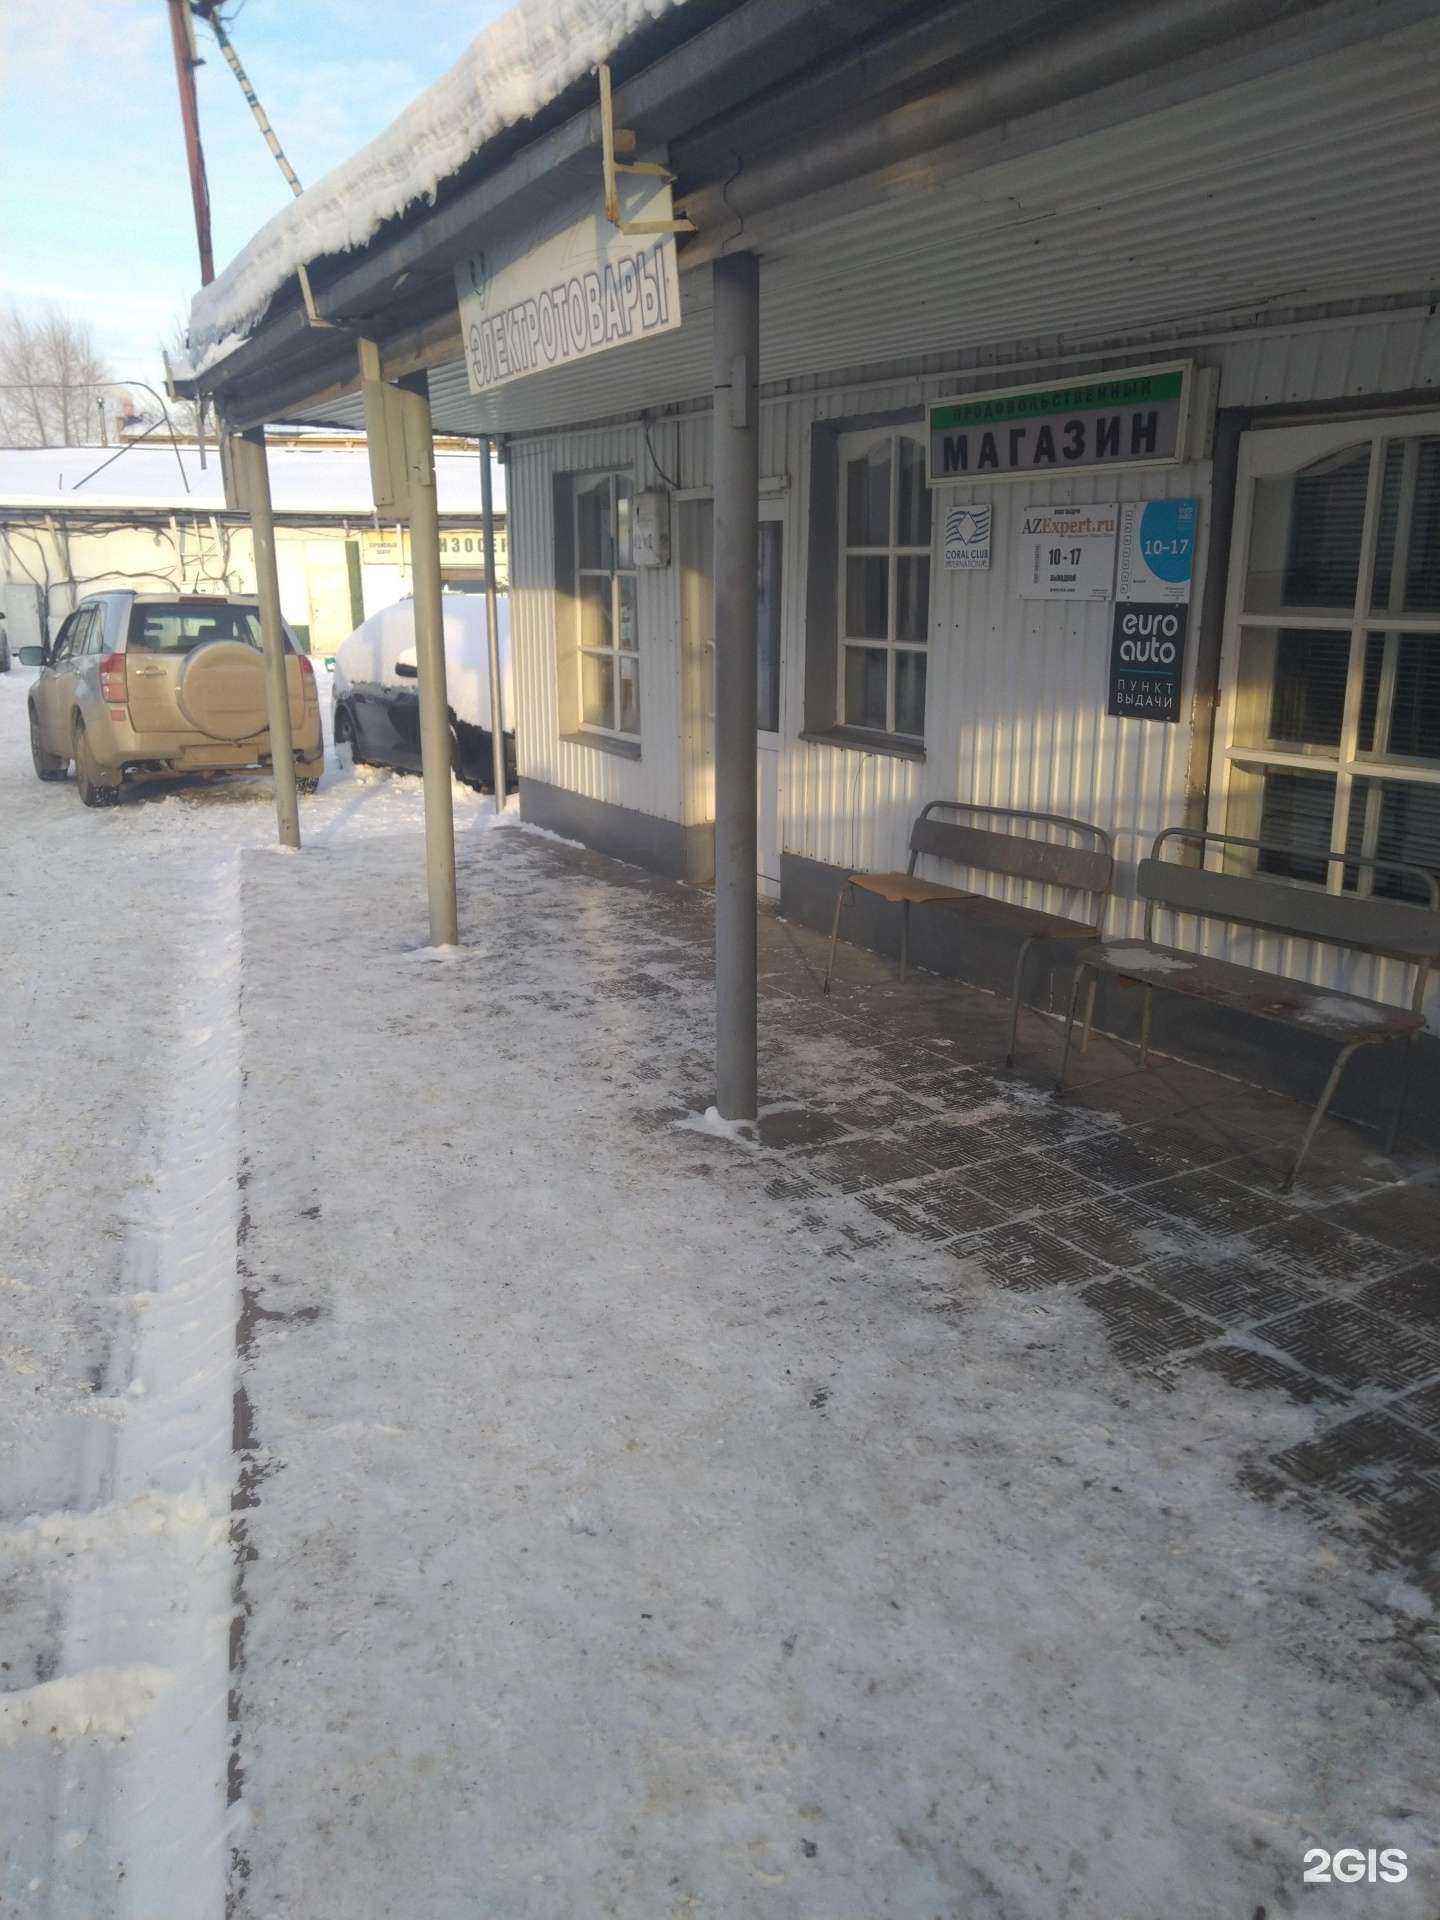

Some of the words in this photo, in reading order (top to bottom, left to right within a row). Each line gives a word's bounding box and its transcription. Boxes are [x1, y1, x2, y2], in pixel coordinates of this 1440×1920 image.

[469, 247, 669, 387] ЭЛЕКТРОТОВАРЫ
[943, 411, 1159, 472] МАГАЗИН
[1022, 518, 1114, 537] AZExpert.ru
[945, 549, 969, 560] CORAL
[970, 548, 989, 559] CLUB
[1122, 612, 1179, 637] euro
[1119, 637, 1177, 664] auto
[1117, 679, 1174, 694] ПУНКТ
[1116, 693, 1174, 709] ВЫДАЧИ
